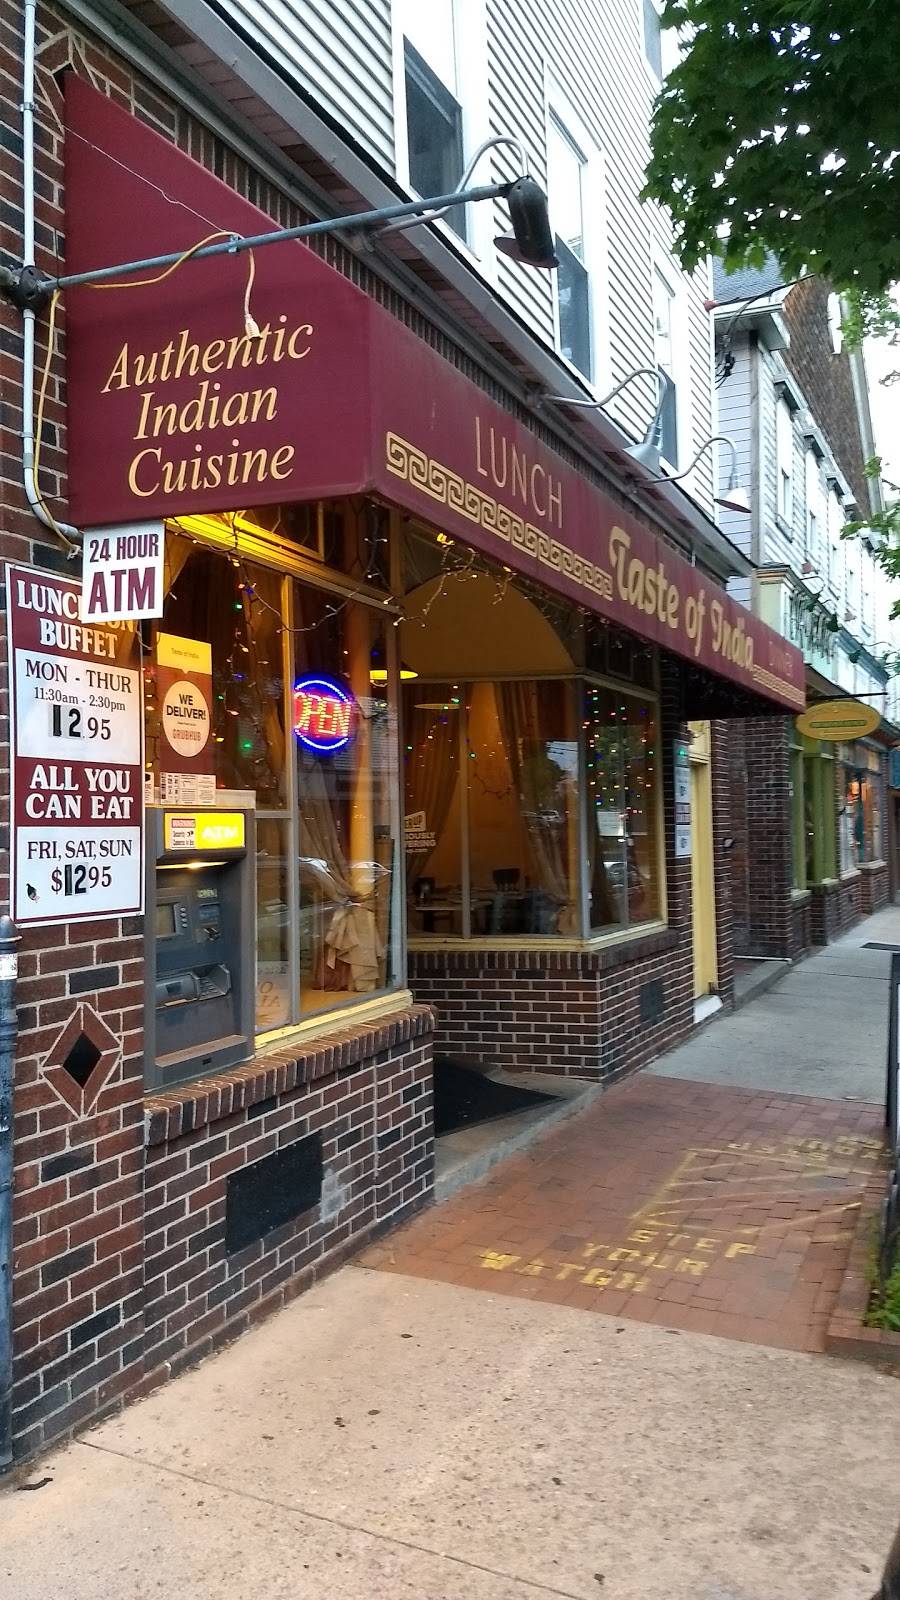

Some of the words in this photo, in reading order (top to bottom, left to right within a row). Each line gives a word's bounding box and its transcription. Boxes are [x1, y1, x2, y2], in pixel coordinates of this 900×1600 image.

[101, 315, 314, 394] Authentic
[133, 381, 278, 441] Indian
[128, 438, 296, 498] Cuisine
[473, 415, 564, 529] LUNCH
[89, 537, 112, 563] 24
[116, 533, 159, 561] HOUR
[88, 566, 156, 614] ATM
[608, 525, 680, 629] Taste
[685, 588, 706, 657] of
[710, 599, 754, 672] India
[39, 617, 118, 659] BUFFET
[25, 658, 68, 684] MON
[86, 669, 132, 694] THUR
[34, 686, 79, 705] 11:30am
[89, 694, 126, 713] 2:30pm
[166, 704, 206, 720] DELIVER!
[178, 693, 193, 706] WE
[30, 764, 79, 791] ALL
[84, 767, 131, 793] YOU
[25, 793, 82, 819] CAN
[90, 795, 134, 819] EAT
[202, 825, 239, 840] ATM
[27, 840, 62, 861] FRI,
[65, 840, 97, 861] SAT,
[100, 839, 133, 857] SUN
[628, 1229, 758, 1258] STEP
[479, 1249, 650, 1293] WATCH
